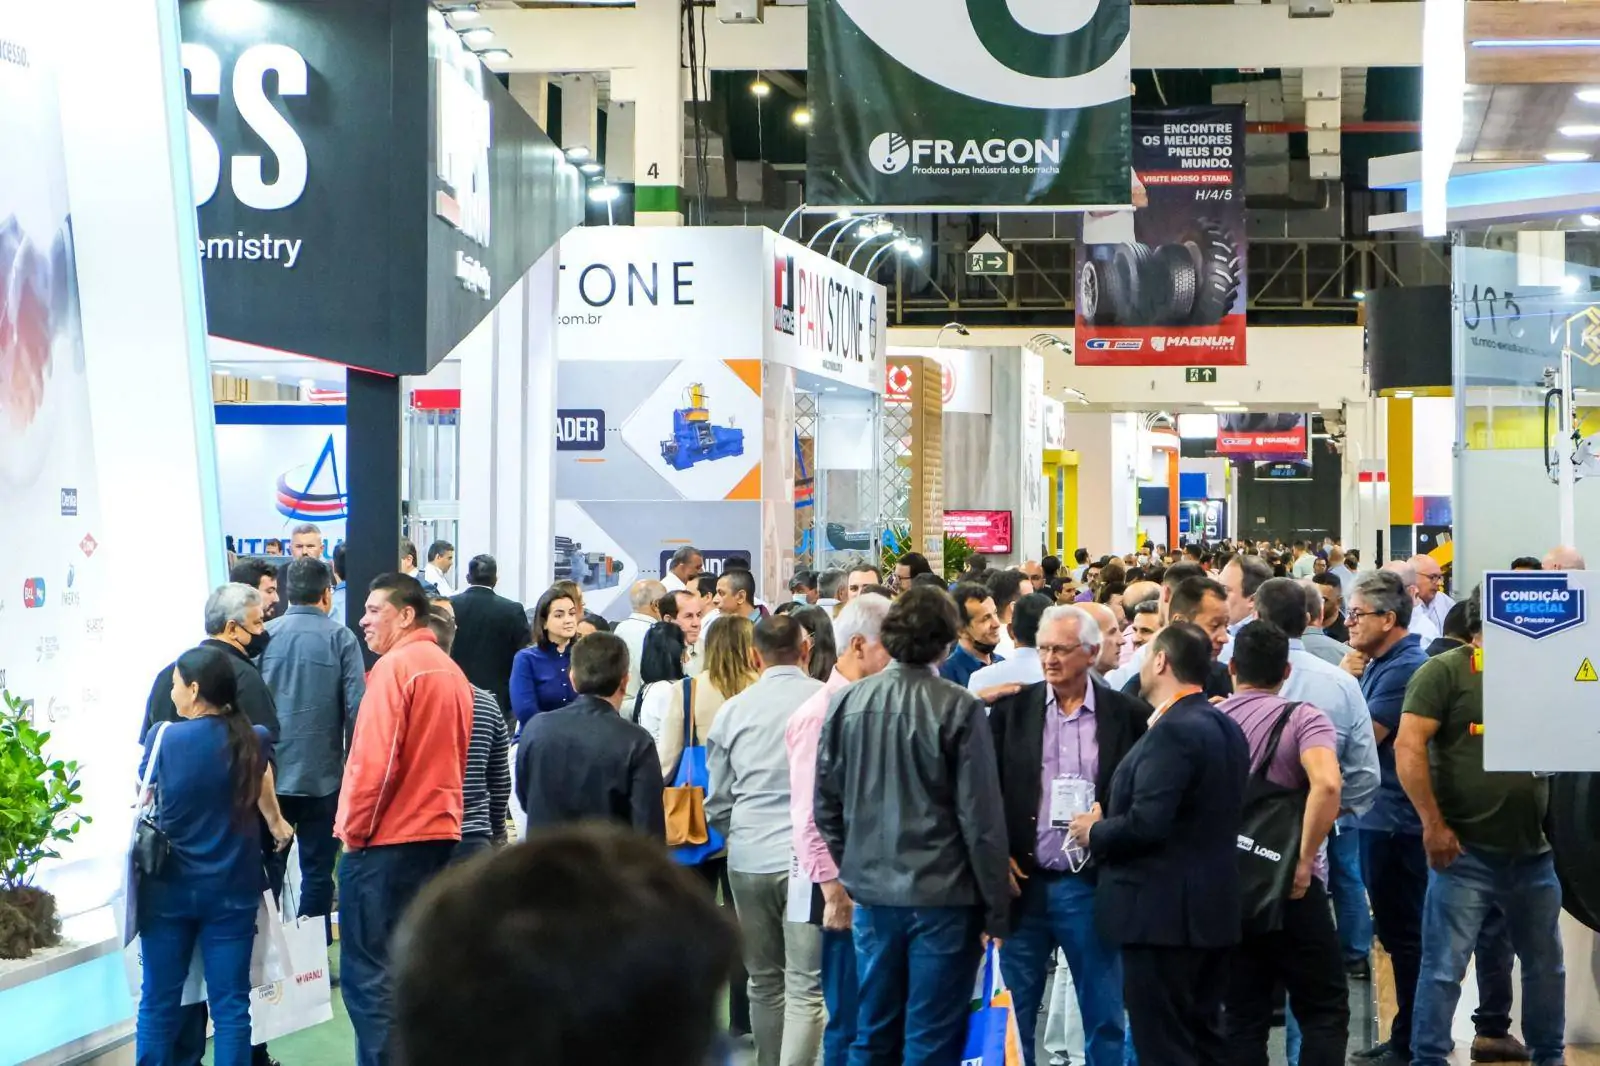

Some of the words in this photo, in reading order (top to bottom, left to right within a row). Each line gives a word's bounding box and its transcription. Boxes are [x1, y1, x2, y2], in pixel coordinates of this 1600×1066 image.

[1163, 123, 1233, 134] ENCONTRE
[1142, 135, 1161, 146] OS
[1164, 135, 1233, 145] MELHORES
[912, 138, 1060, 165] FRAGON
[1167, 146, 1210, 157] PNEUS
[1213, 146, 1233, 157] DO
[1181, 158, 1233, 169] MUNDO.
[647, 162, 660, 180] 4
[912, 166, 950, 174] Produtos
[952, 167, 970, 176] para
[972, 165, 1007, 174] Indústria
[1009, 165, 1021, 174] de
[1022, 165, 1060, 174] Borracha
[1143, 175, 1169, 183] VISITE
[1195, 189, 1233, 200] H/4/5
[559, 261, 695, 307] ONE
[558, 313, 603, 325] om.br
[1166, 335, 1235, 347] MAGNUM
[1501, 588, 1570, 603] CONDIÇÃO
[1505, 603, 1566, 613] ESPECIAL
[1254, 845, 1281, 861] LORD
[303, 968, 323, 983] WANLI
